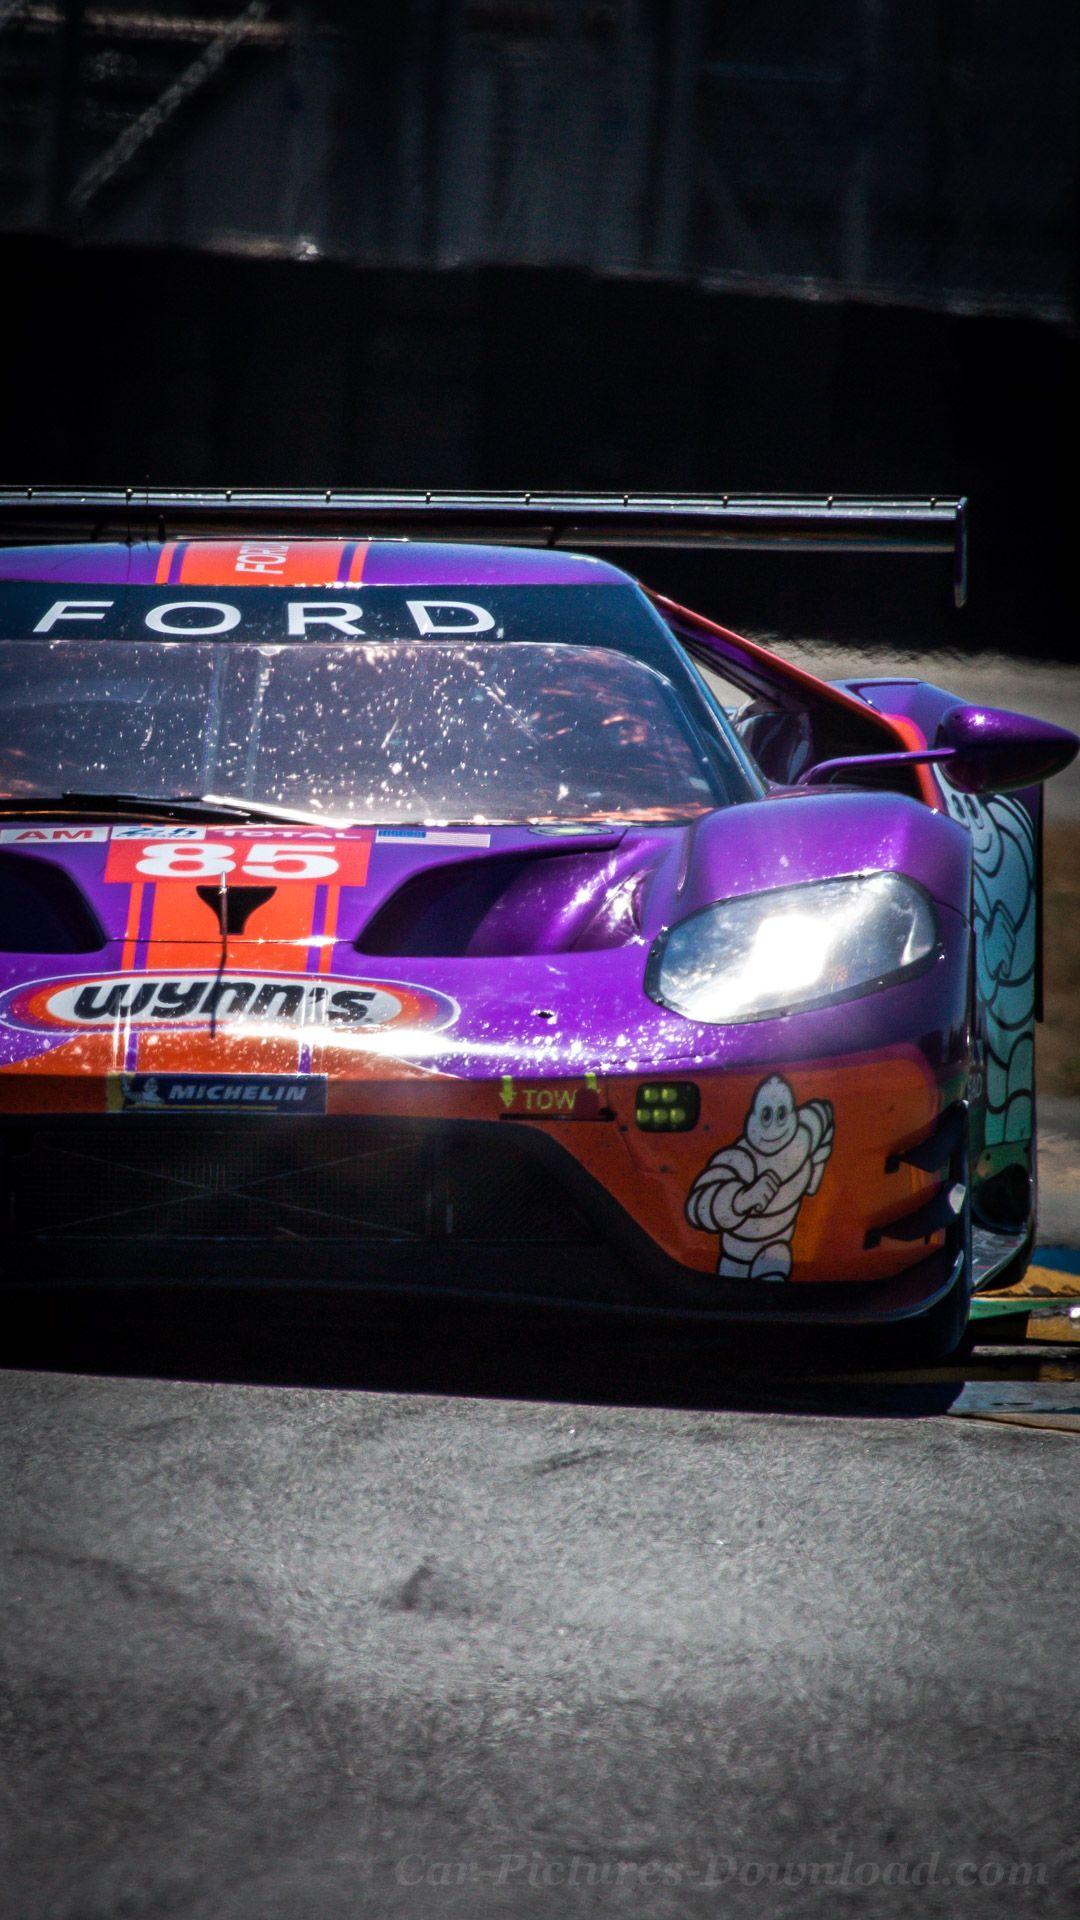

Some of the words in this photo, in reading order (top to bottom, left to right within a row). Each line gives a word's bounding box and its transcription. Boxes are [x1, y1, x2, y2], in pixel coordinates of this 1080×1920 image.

[32, 600, 496, 635] FORD
[15, 830, 94, 840] AM
[215, 829, 361, 840] TOTAL
[135, 843, 339, 879] 85
[168, 1085, 307, 1101] MICHELIN
[522, 1089, 577, 1110] TOW
